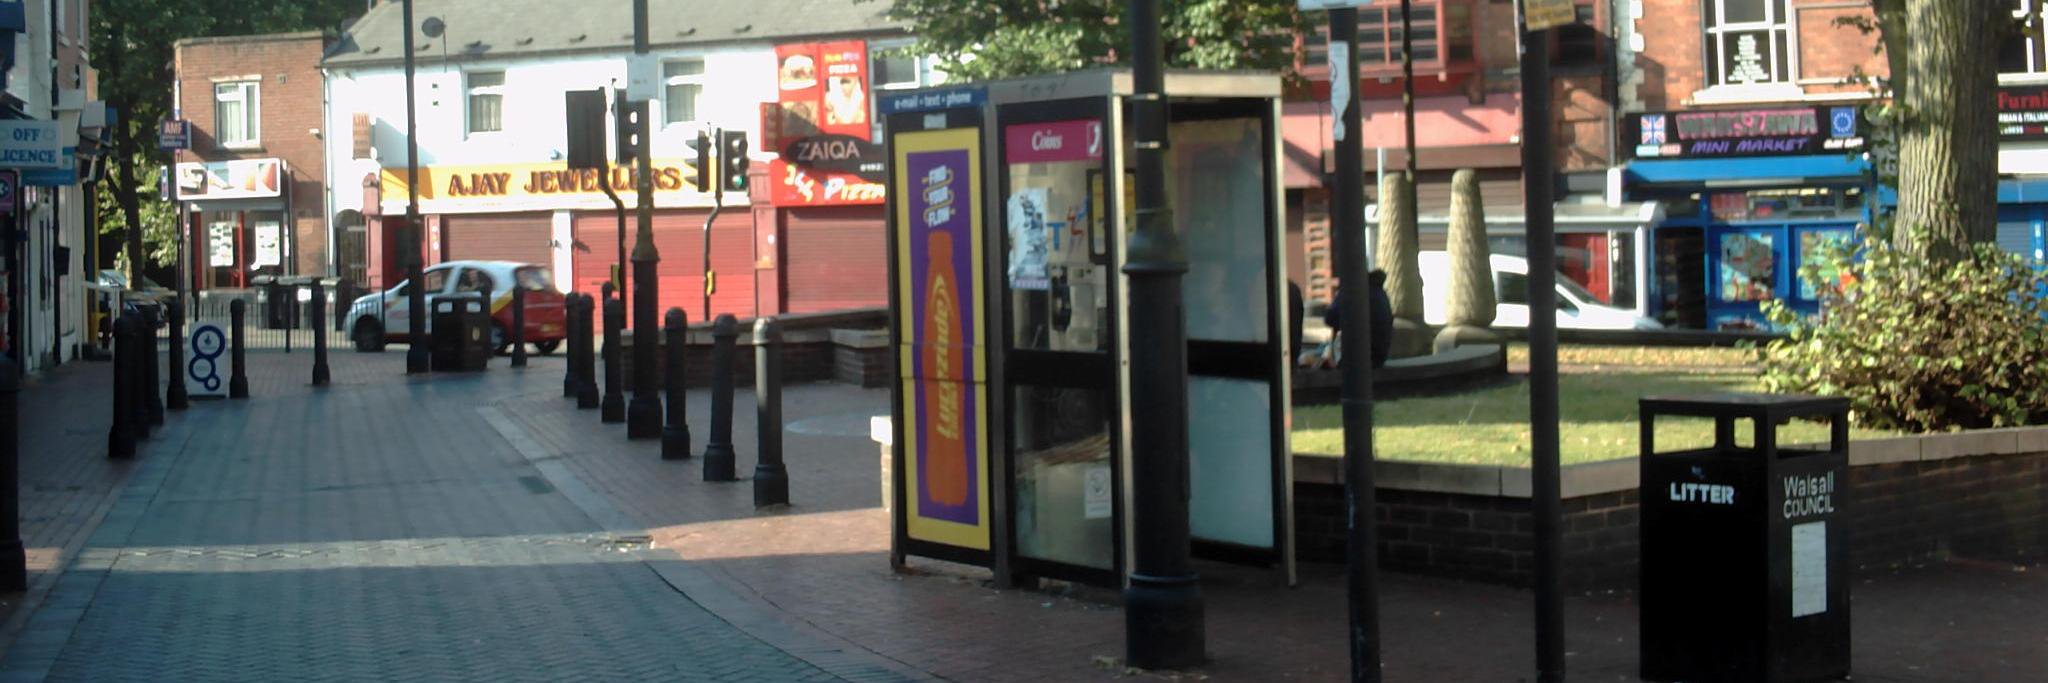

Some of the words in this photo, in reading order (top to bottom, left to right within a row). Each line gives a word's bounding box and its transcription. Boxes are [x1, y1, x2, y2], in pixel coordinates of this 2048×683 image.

[894, 95, 919, 110] e-mail
[924, 94, 941, 107] text
[946, 92, 972, 108] phone
[13, 127, 41, 142] OFF
[1031, 129, 1063, 151] Coins
[1690, 139, 1728, 154] MINI
[1735, 137, 1809, 152] MARKET
[797, 141, 861, 161] ZAIQA
[448, 173, 511, 196] AJAY
[524, 168, 682, 193] JEWELERS
[928, 206, 950, 228] FLOW
[1670, 482, 1735, 505] LITTER
[1783, 471, 1835, 497] Walsall
[1782, 494, 1835, 519] COUNCIL
